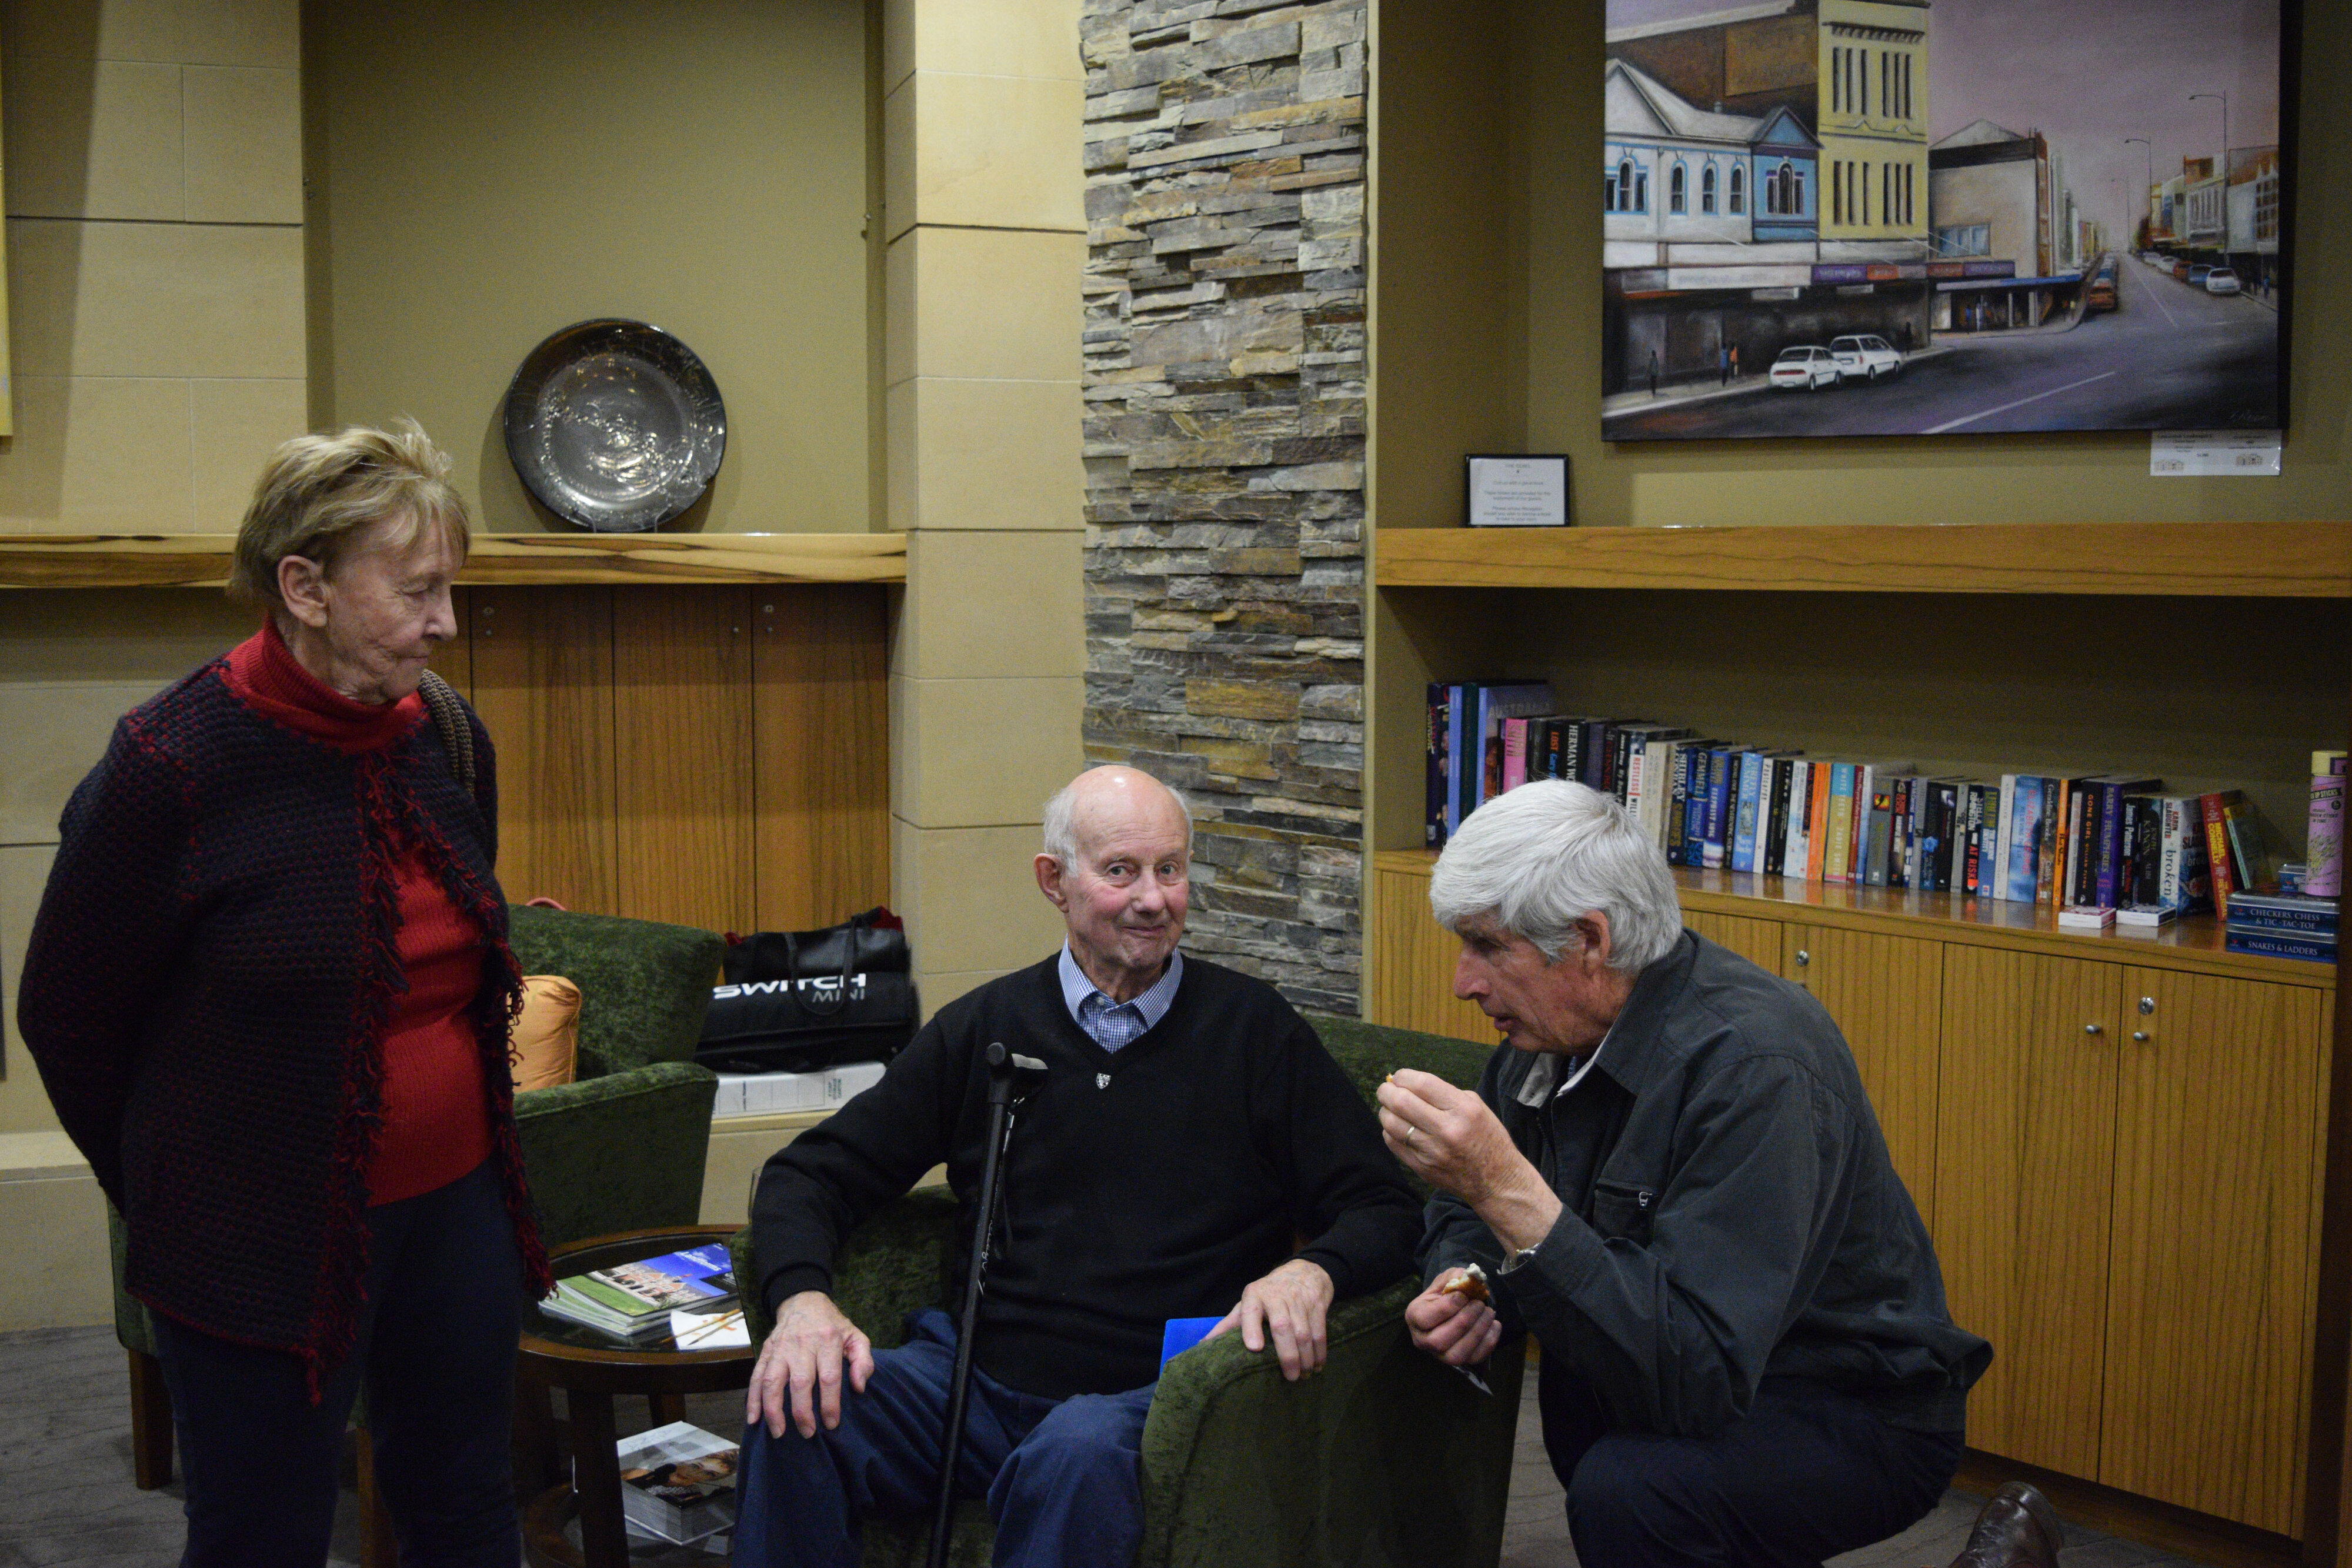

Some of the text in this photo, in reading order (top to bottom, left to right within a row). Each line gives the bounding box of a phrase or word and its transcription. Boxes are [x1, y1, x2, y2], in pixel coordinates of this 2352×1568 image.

[1551, 731, 1560, 752] LOST
[1569, 724, 1577, 766] HERMAN
[1632, 757, 1640, 792] RESTLESS
[1678, 753, 1687, 802] SHIRLEY
[1696, 752, 1707, 796] GEMMELL
[1969, 792, 1978, 831] RIMINGTON
[1976, 798, 1984, 826] STELLA
[2044, 783, 2054, 842] Geraldine Brooks
[2106, 786, 2114, 816] BARRY
[2125, 803, 2136, 825] James
[2022, 789, 2036, 876] ELIZABETH GEORGE
[2143, 819, 2151, 856] KANON
[2165, 802, 2173, 839] SLAUGHTER
[2102, 819, 2112, 874] HUMPHRIES
[2124, 826, 2134, 856] Patterson
[2208, 823, 2220, 865] CONNELLY
[2215, 822, 2226, 860] MICHAEL
[1833, 852, 1841, 875] SMITH
[1969, 845, 1978, 879] AT RISK
[2165, 849, 2177, 897] broken
[2294, 912, 2320, 921] CHESS
[2247, 941, 2275, 951] SNAKES
[2284, 945, 2318, 956] LADDERS
[712, 973, 867, 1000] SWITCH
[812, 988, 866, 1003] MINI
